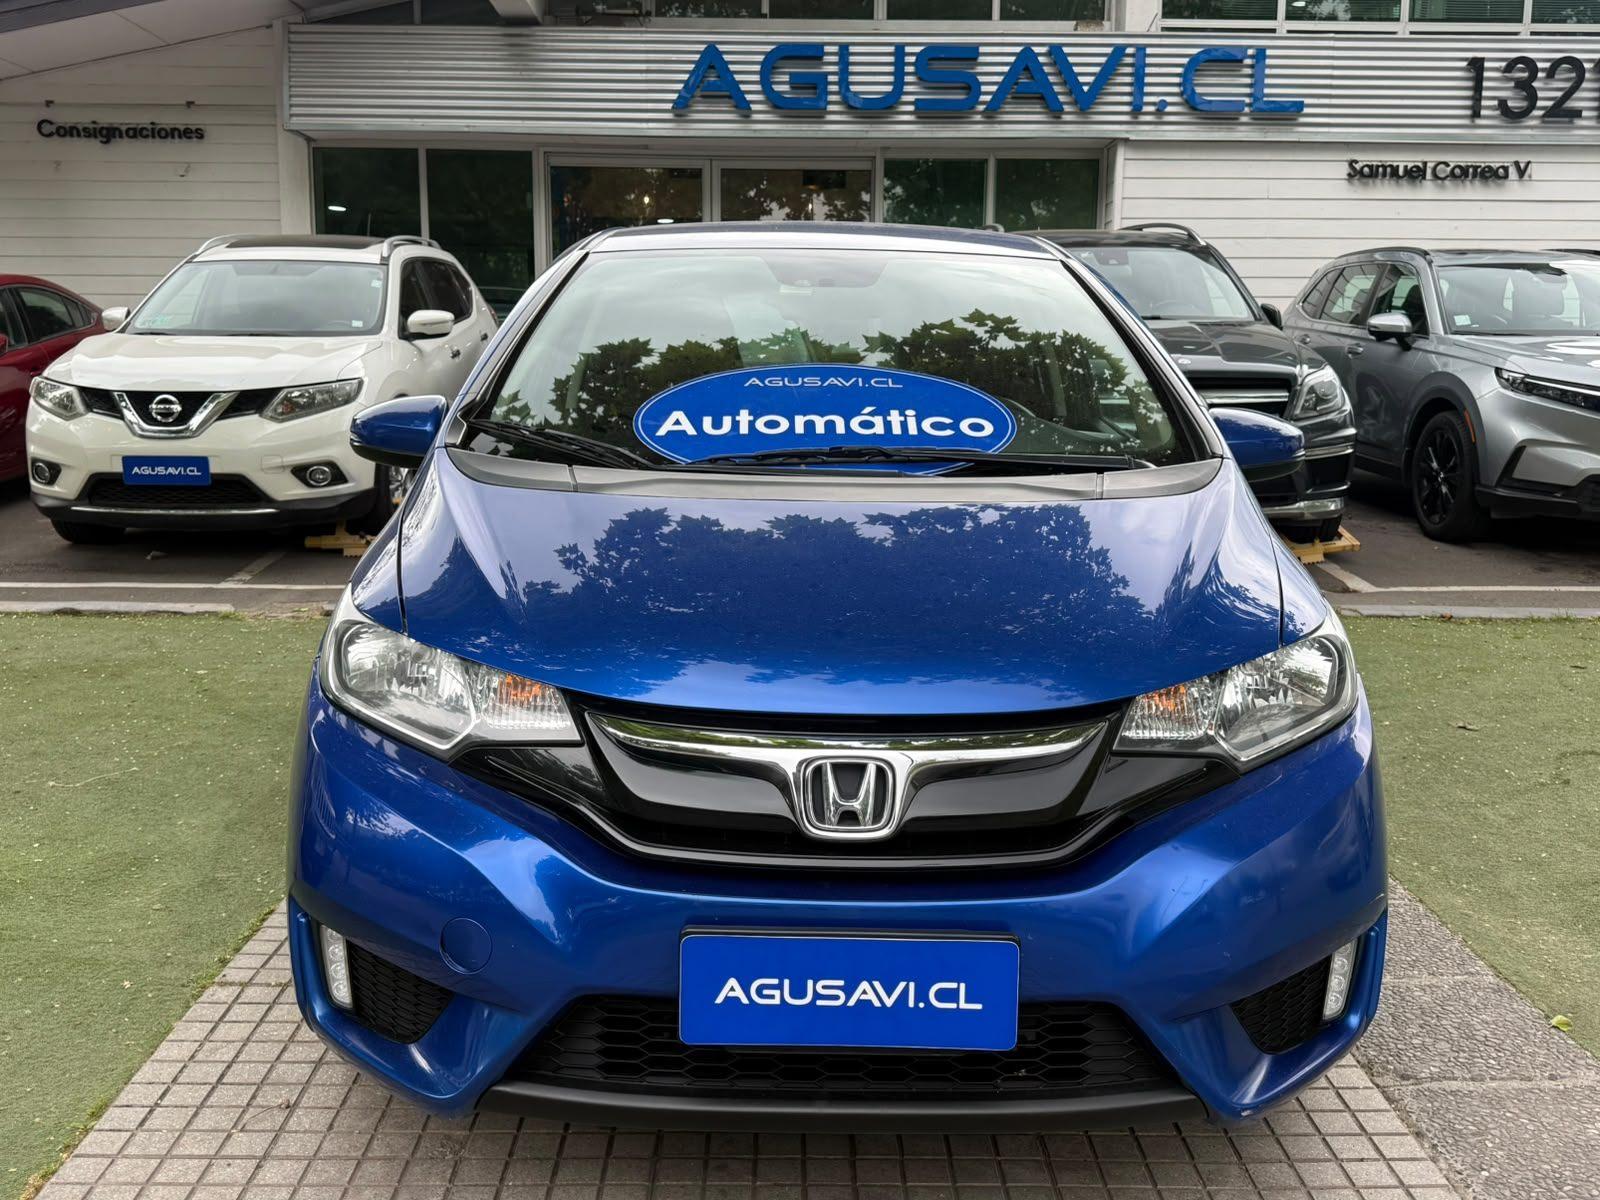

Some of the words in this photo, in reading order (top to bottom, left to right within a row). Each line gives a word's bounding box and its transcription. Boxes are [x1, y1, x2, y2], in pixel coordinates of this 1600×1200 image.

[671, 43, 1305, 115] AGUSAVI.CL
[36, 119, 205, 145] Consignaciones
[1347, 159, 1427, 180] Samuel
[1432, 161, 1510, 181] Correa
[743, 377, 904, 389] AGUSAVI.CL
[654, 406, 995, 438] Automático
[131, 466, 202, 476] AGUSAVI.CL
[714, 977, 983, 1010] AGUSAVI.CL
